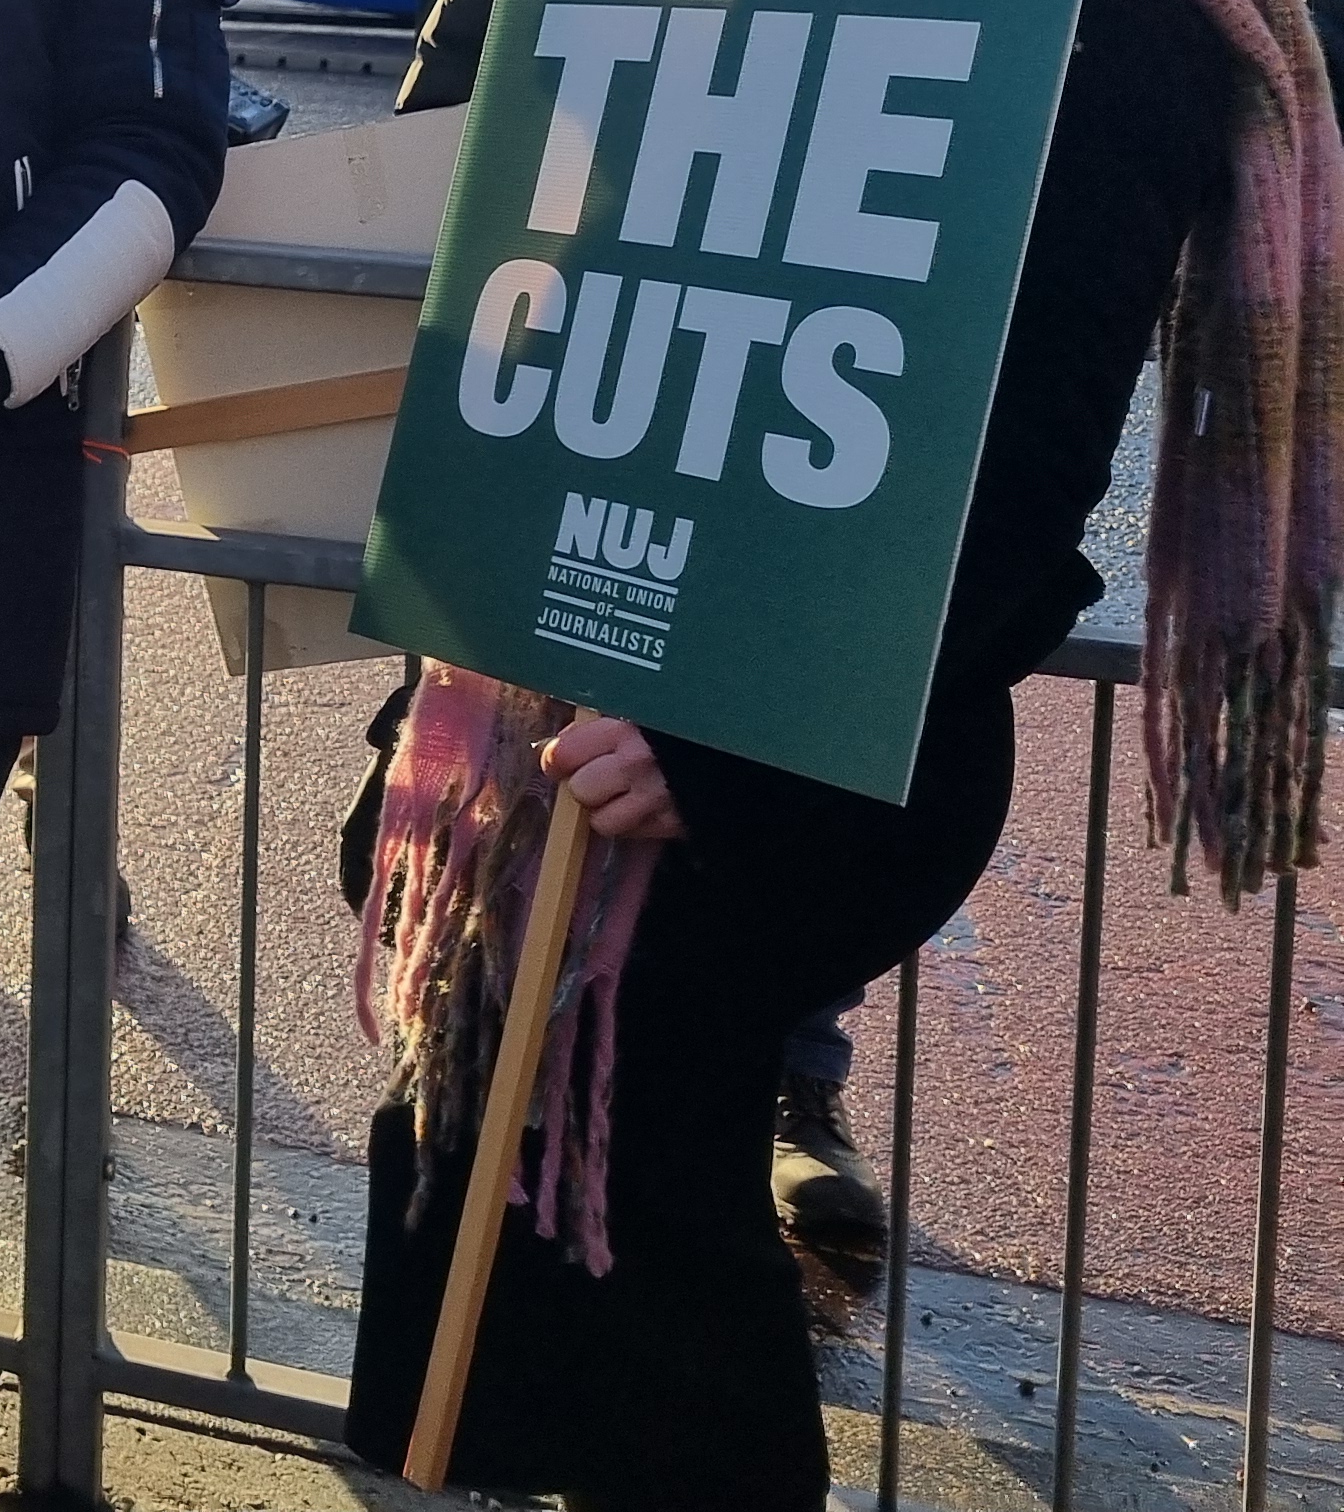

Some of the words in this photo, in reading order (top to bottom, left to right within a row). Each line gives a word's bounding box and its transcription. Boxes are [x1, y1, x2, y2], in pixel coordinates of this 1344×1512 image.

[526, 4, 981, 283] THE
[458, 258, 905, 509] CUTS
[555, 491, 694, 581] NUJ
[548, 566, 619, 598] NATIONAL
[626, 586, 676, 613] UNION
[596, 602, 613, 617] OF
[537, 607, 665, 658] JOURNALISTS
